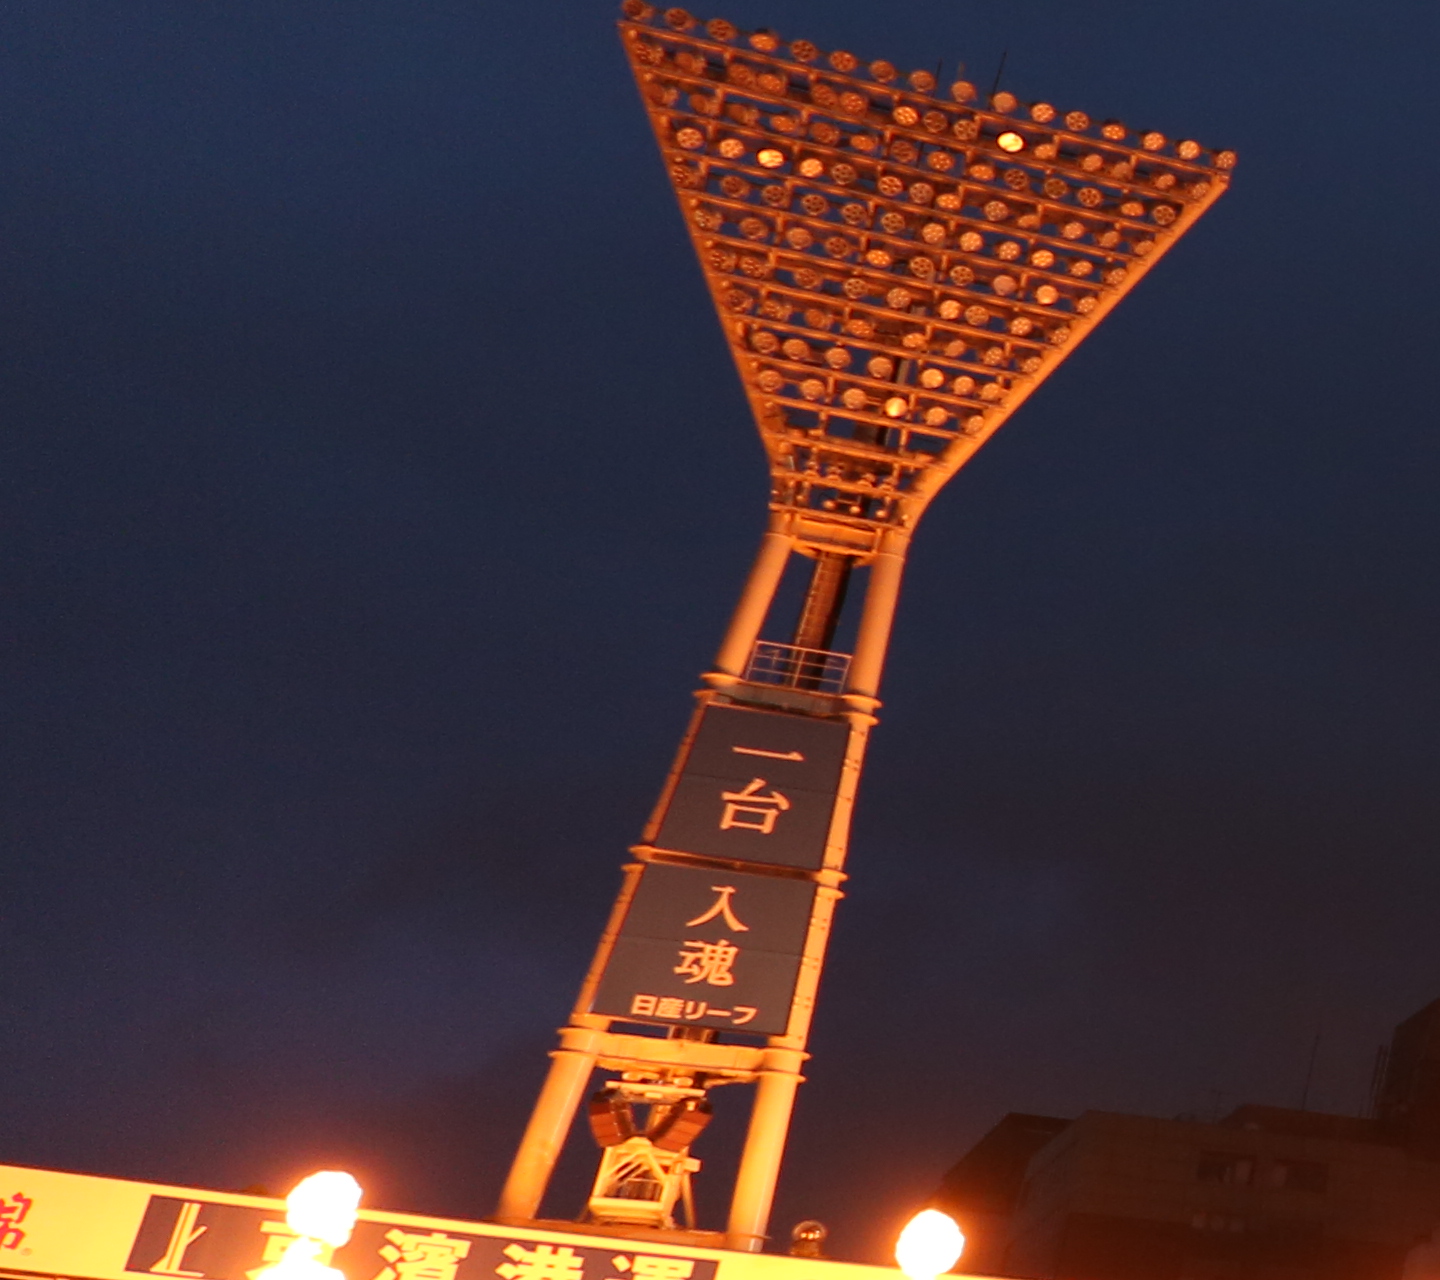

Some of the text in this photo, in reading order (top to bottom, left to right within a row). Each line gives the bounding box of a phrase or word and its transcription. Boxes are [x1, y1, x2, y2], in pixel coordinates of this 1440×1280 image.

[672, 745, 804, 987] 一台入魂
[630, 994, 758, 1025] 日産リーフ
